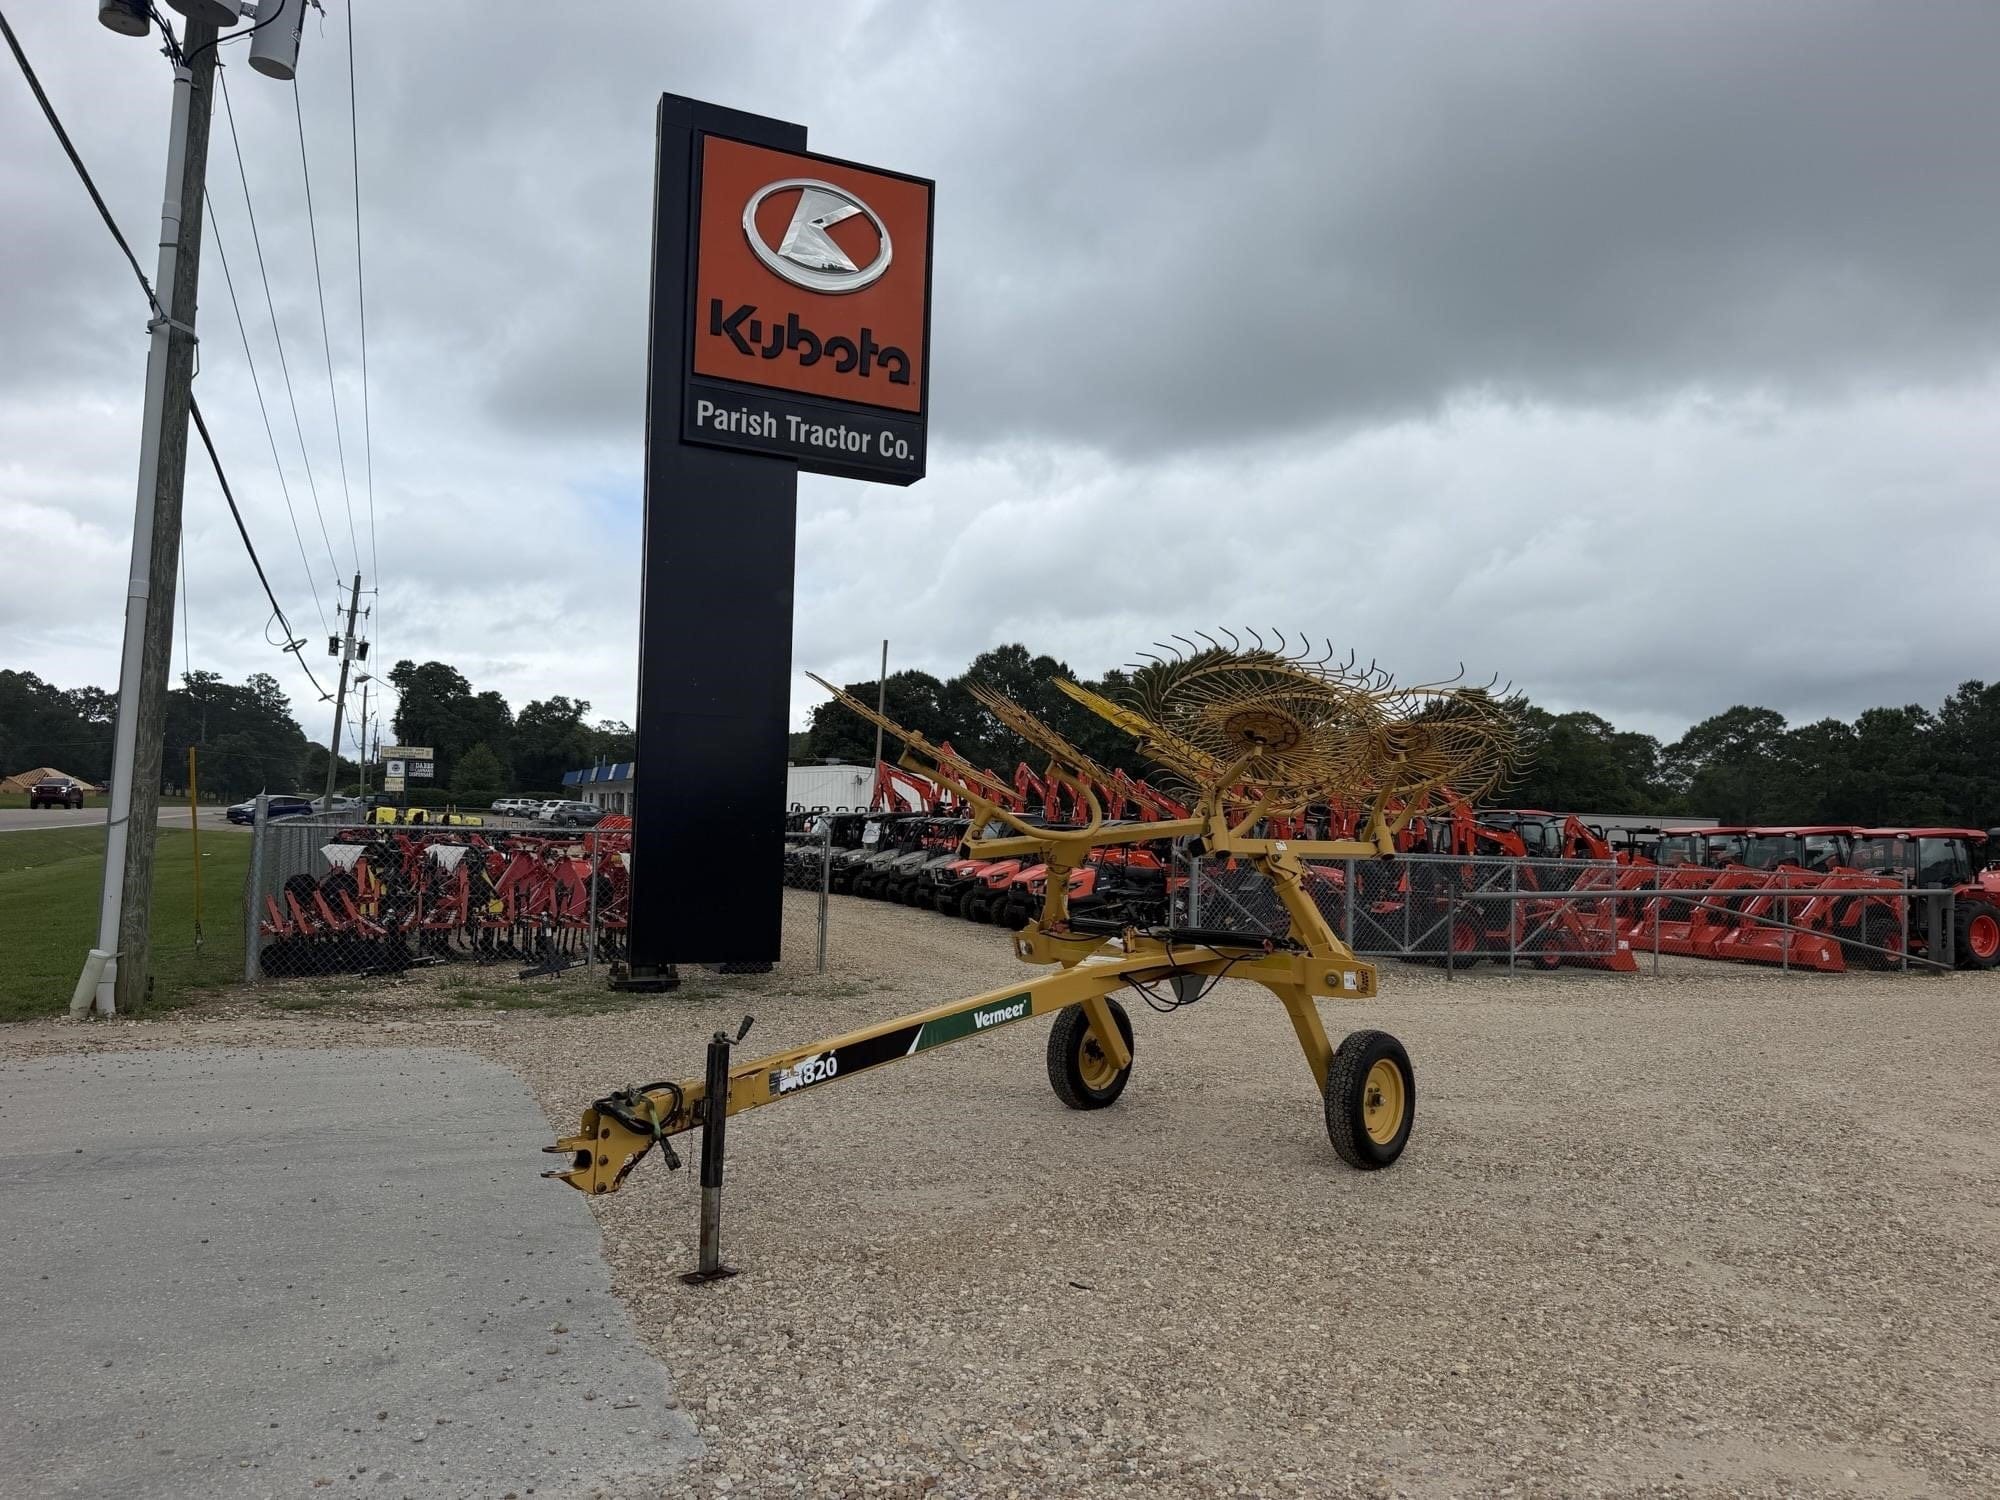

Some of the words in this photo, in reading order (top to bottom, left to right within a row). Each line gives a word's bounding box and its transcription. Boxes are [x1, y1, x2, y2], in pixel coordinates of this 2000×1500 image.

[710, 298, 911, 385] Kubota
[696, 400, 777, 438] Parish
[786, 415, 871, 453] Tractor
[879, 431, 915, 461] Co.
[974, 1003, 1024, 1029] Vermeer
